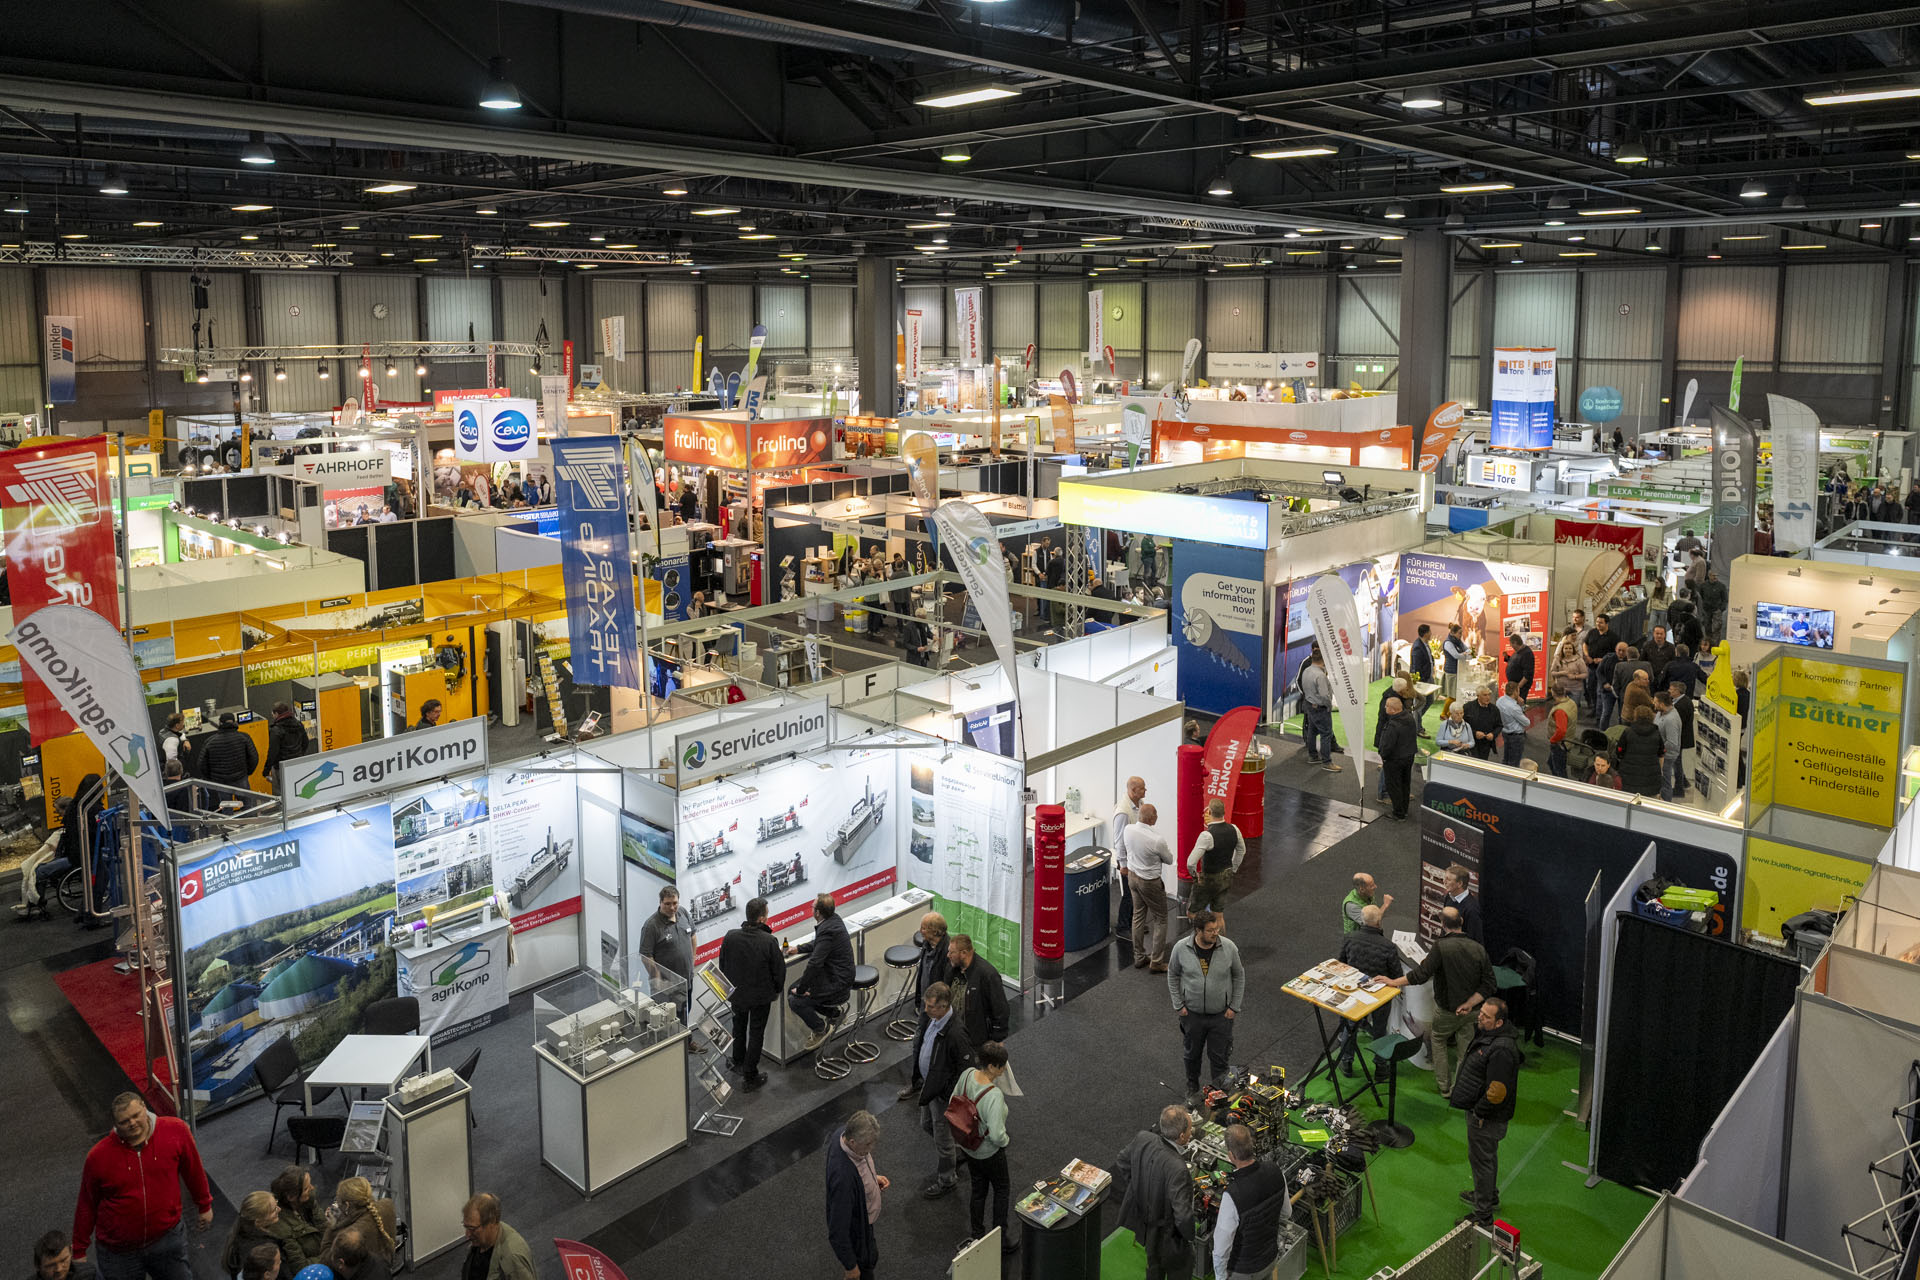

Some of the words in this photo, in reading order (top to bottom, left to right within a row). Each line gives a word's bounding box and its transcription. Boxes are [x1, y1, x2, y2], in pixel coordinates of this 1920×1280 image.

[51, 323, 62, 361] winkler
[1509, 360, 1525, 368] ITB
[1658, 436, 1700, 446] LKS-Labor
[316, 458, 384, 475] AHRHOFF
[1497, 463, 1517, 476] ITB
[1496, 474, 1517, 485] Tore
[1612, 488, 1631, 496] LEXA
[1639, 490, 1691, 502] Tierernährung
[1406, 558, 1421, 567] FÜR
[1422, 562, 1446, 570] IHREN
[1406, 568, 1458, 582] WACHSENDEN
[1406, 576, 1437, 588] ERFOLG.
[1202, 588, 1256, 605] information
[1217, 581, 1238, 592] Get
[1238, 585, 1256, 596] your
[322, 598, 349, 607] ETA
[1232, 604, 1256, 616] now!
[247, 652, 328, 672] NACHHALTIGKIT
[260, 658, 338, 681] INNOVATON
[865, 673, 876, 696] F
[1791, 670, 1802, 678] Ihr
[1804, 672, 1858, 687] kompetenter
[1859, 680, 1892, 692] Partner
[1789, 702, 1891, 734] Büttner
[712, 713, 824, 761] ServiceUnion
[352, 738, 478, 783] agriKomp
[1796, 740, 1886, 767] Schweineställe
[1218, 740, 1240, 798] PANOLIN
[1802, 758, 1884, 784] Geflügelställe
[1208, 769, 1220, 795] Shell
[1808, 775, 1880, 799] Rinderställe
[492, 804, 511, 813] DELTA
[512, 799, 528, 808] PEAK
[492, 803, 541, 820] BHKW-Container
[682, 802, 691, 812] Ihr
[692, 797, 716, 810] Partner
[682, 808, 710, 821] moderne
[710, 792, 760, 812] BHKW-Lösungen
[1431, 800, 1500, 824] FARMSHOP
[204, 842, 296, 881] BIOMETHAN
[253, 862, 294, 878] AUFBEREITUNG
[206, 878, 220, 888] ALLES
[230, 870, 247, 878] EINER
[1751, 854, 1864, 888] www.buettner-agrartechnik.de
[530, 912, 561, 926] Energietechnik
[771, 910, 805, 929] Energietechnik
[431, 972, 490, 1002] agriKomp
